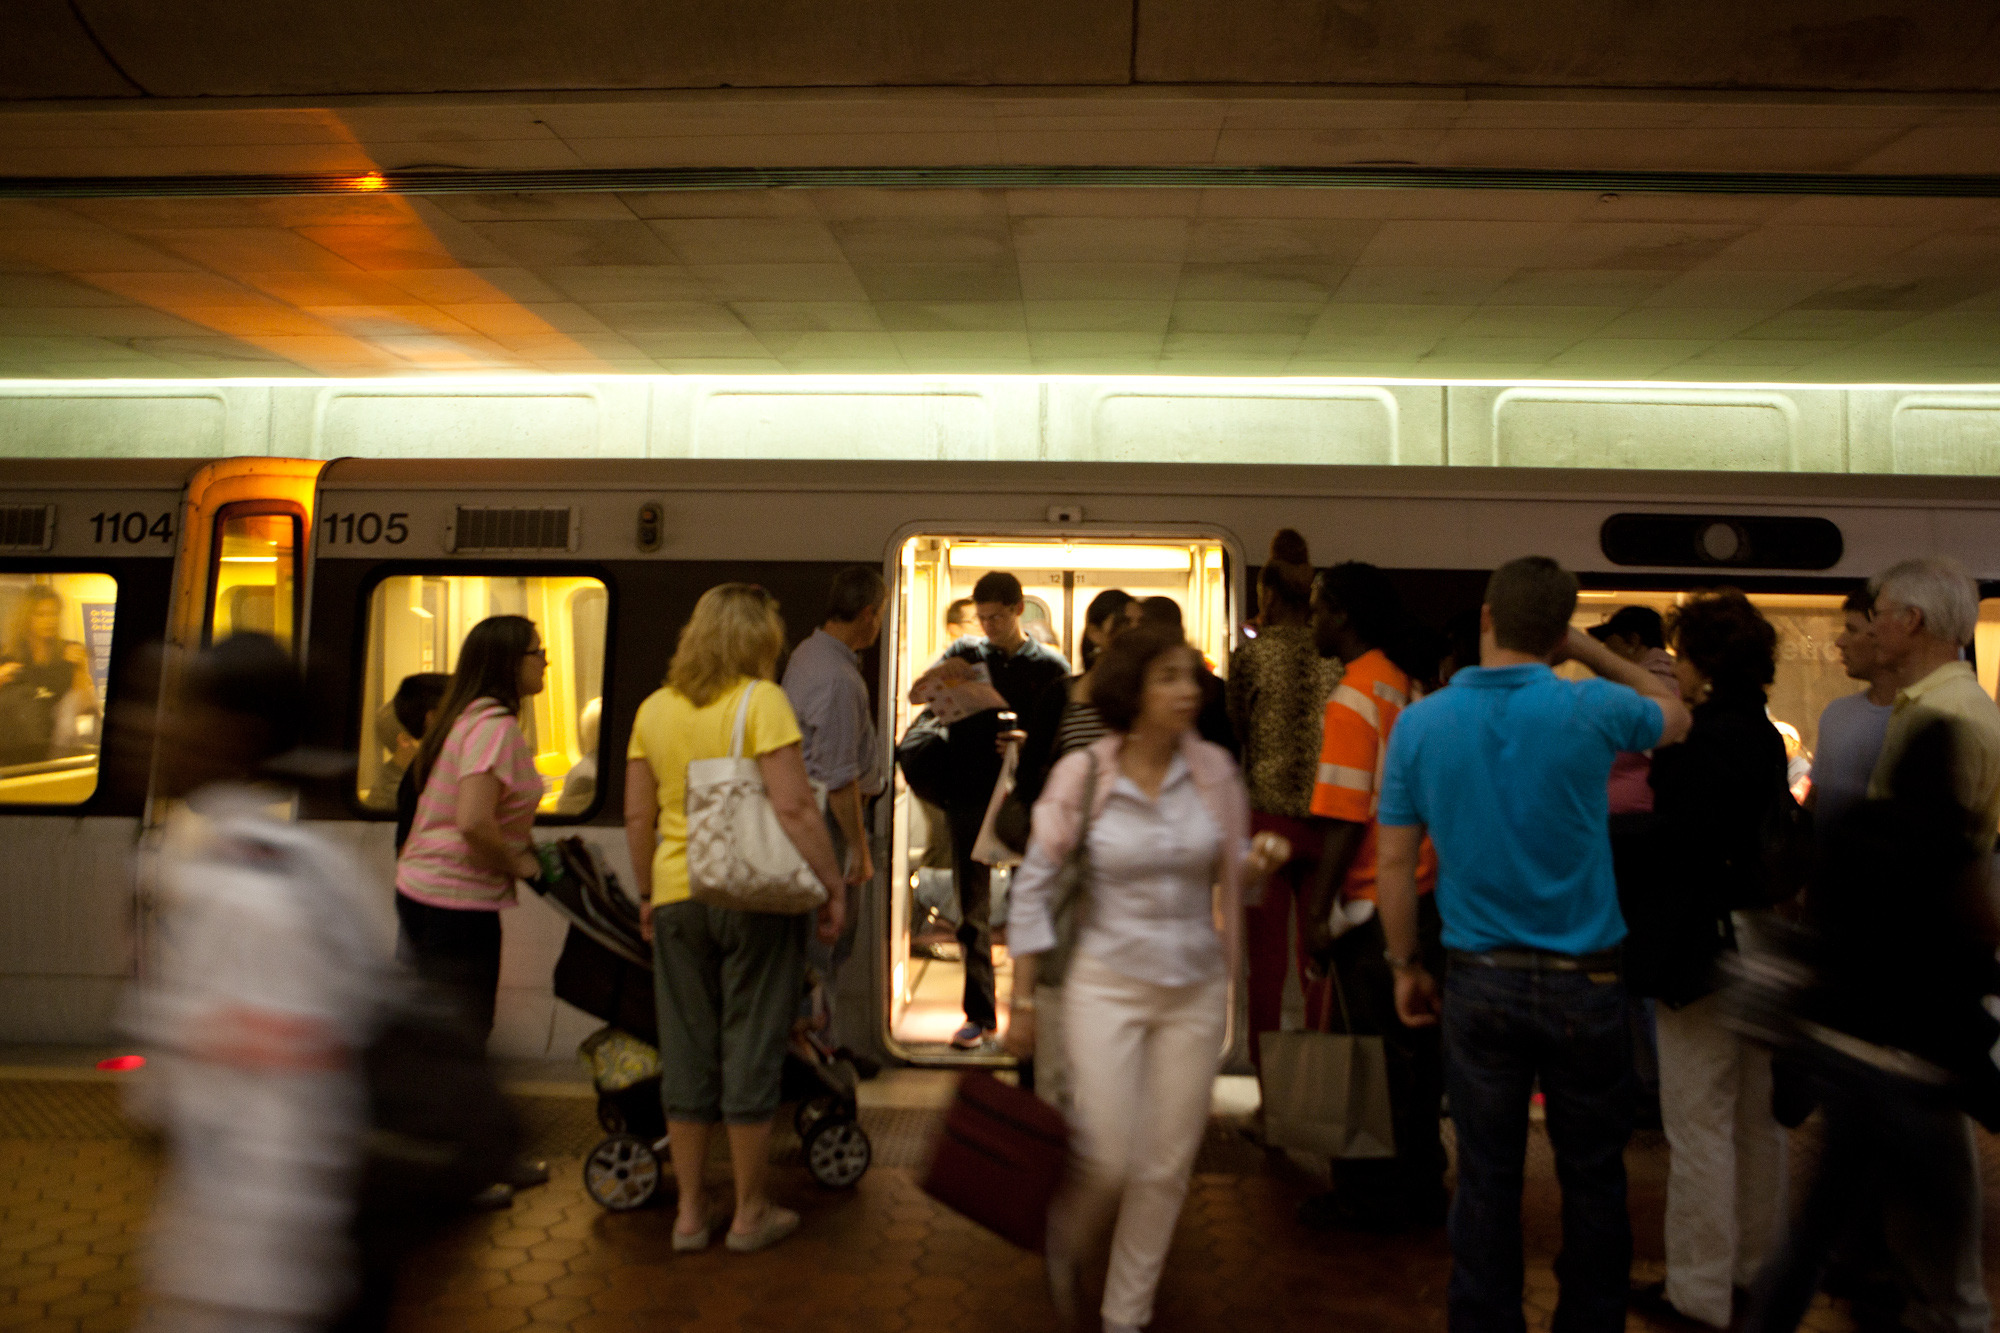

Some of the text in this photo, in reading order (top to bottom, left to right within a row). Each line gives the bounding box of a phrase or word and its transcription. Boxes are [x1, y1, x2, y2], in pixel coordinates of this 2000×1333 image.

[90, 511, 174, 544] 1104
[323, 512, 410, 545] 1105
[1050, 574, 1061, 583] 12
